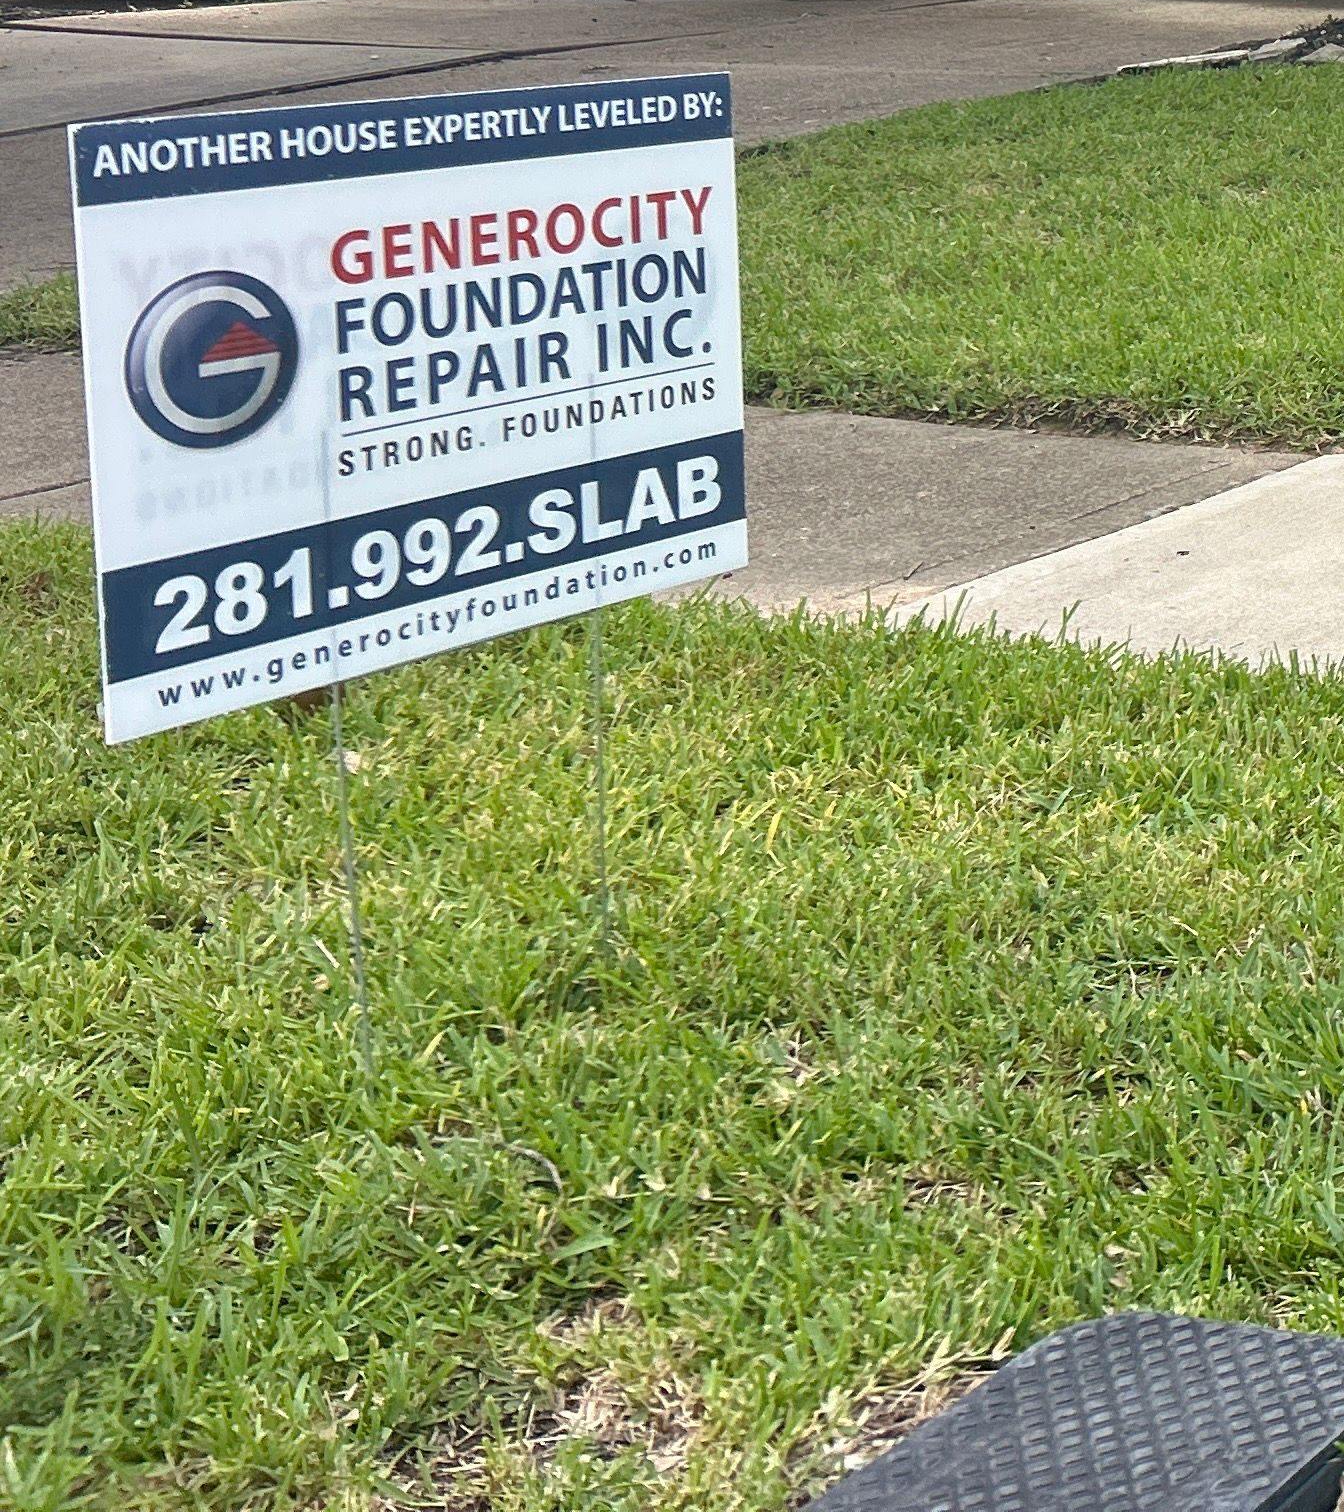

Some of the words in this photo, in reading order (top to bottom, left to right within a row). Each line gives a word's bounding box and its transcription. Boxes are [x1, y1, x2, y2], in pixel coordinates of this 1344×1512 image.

[93, 131, 273, 178] ANOTHER
[280, 120, 397, 159] HOUSE
[403, 106, 551, 147] EXPERTLY
[558, 95, 677, 132] LEVELED
[683, 91, 723, 120] BY:
[330, 186, 713, 285] GENEROCITY
[335, 247, 707, 355] FOUNDATION
[338, 331, 572, 422] REPAIR
[596, 308, 713, 373] INC.
[337, 425, 487, 477] STRONG.
[502, 377, 716, 442] FOUNDATIONS
[153, 455, 722, 655] 281.992.SLAB
[157, 540, 718, 707] www.generocityfoundation.com
